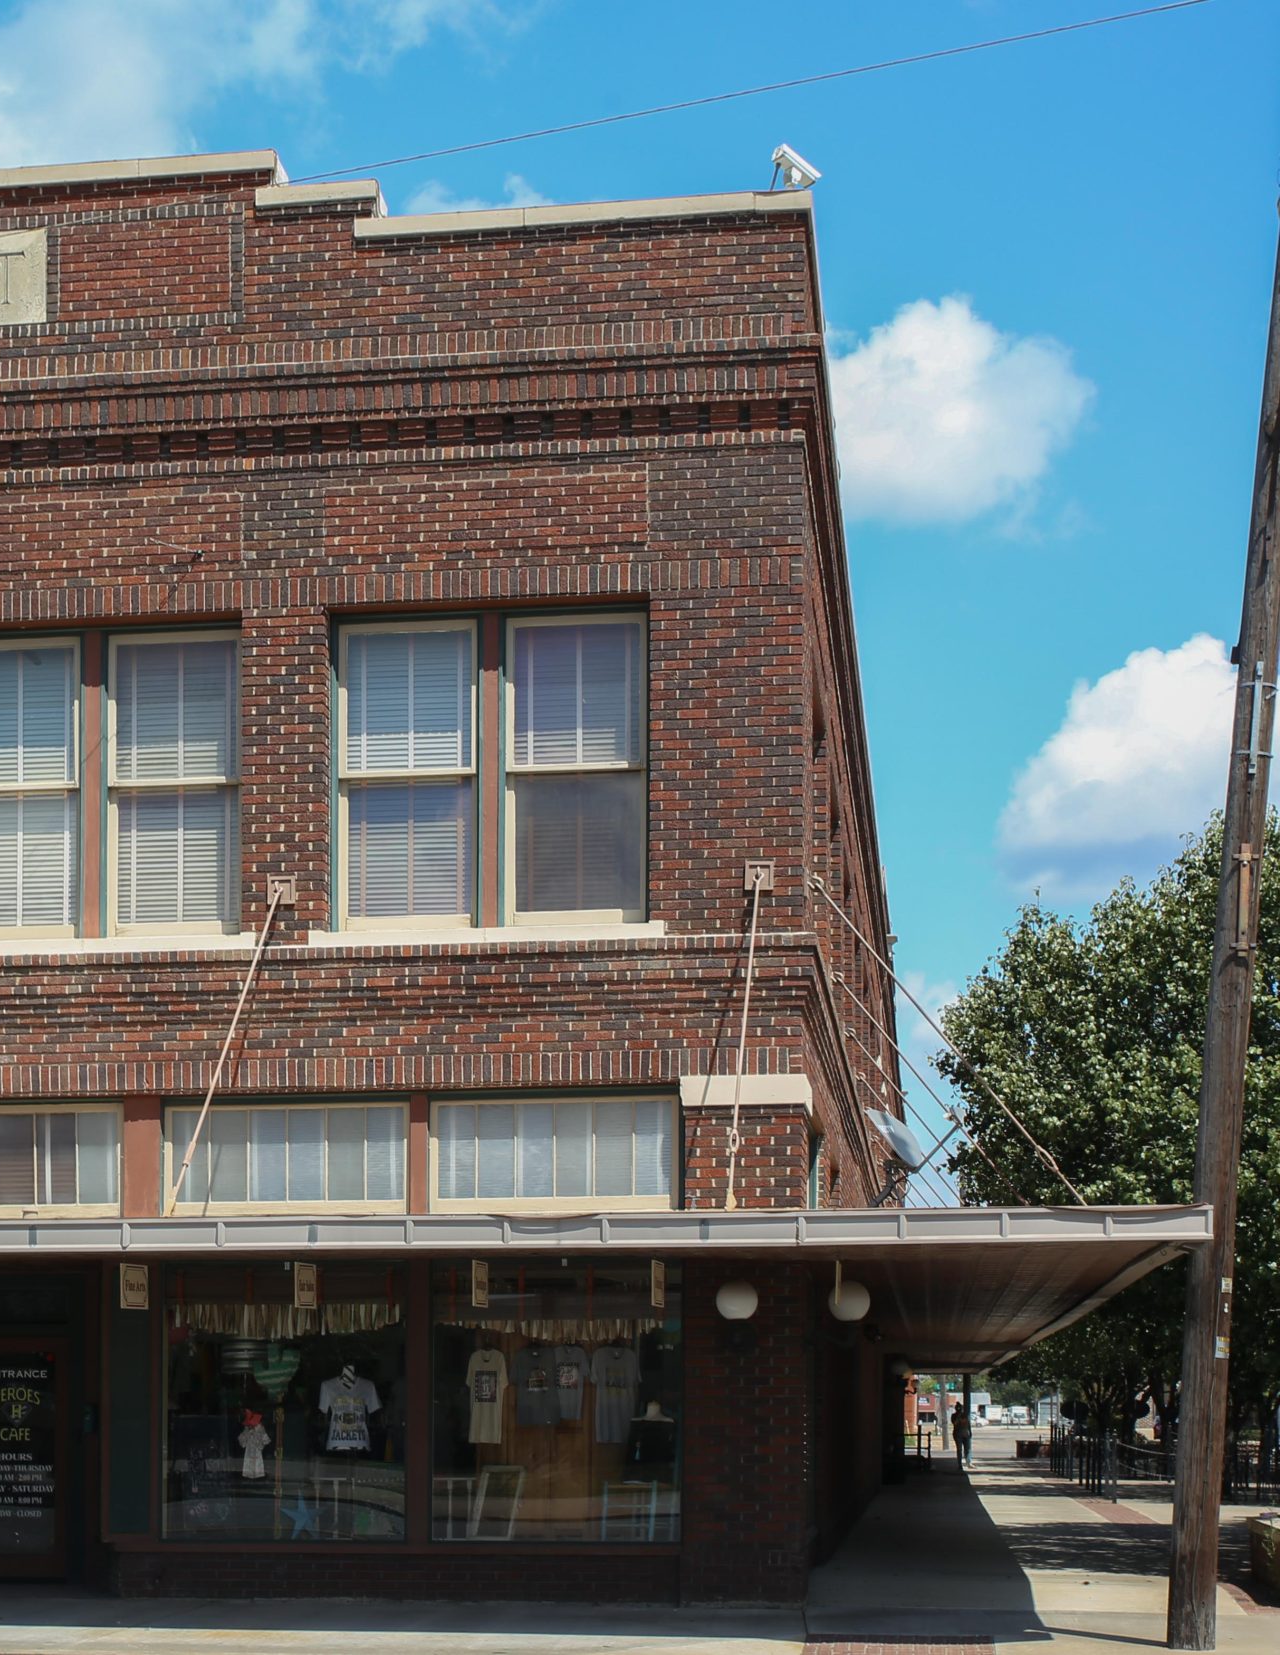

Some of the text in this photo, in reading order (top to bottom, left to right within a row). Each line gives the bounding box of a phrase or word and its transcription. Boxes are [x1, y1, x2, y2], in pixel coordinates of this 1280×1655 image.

[0, 1428, 31, 1442] CAFE
[12, 1484, 55, 1493] SATURDAY
[16, 1509, 42, 1518] CLOSED
